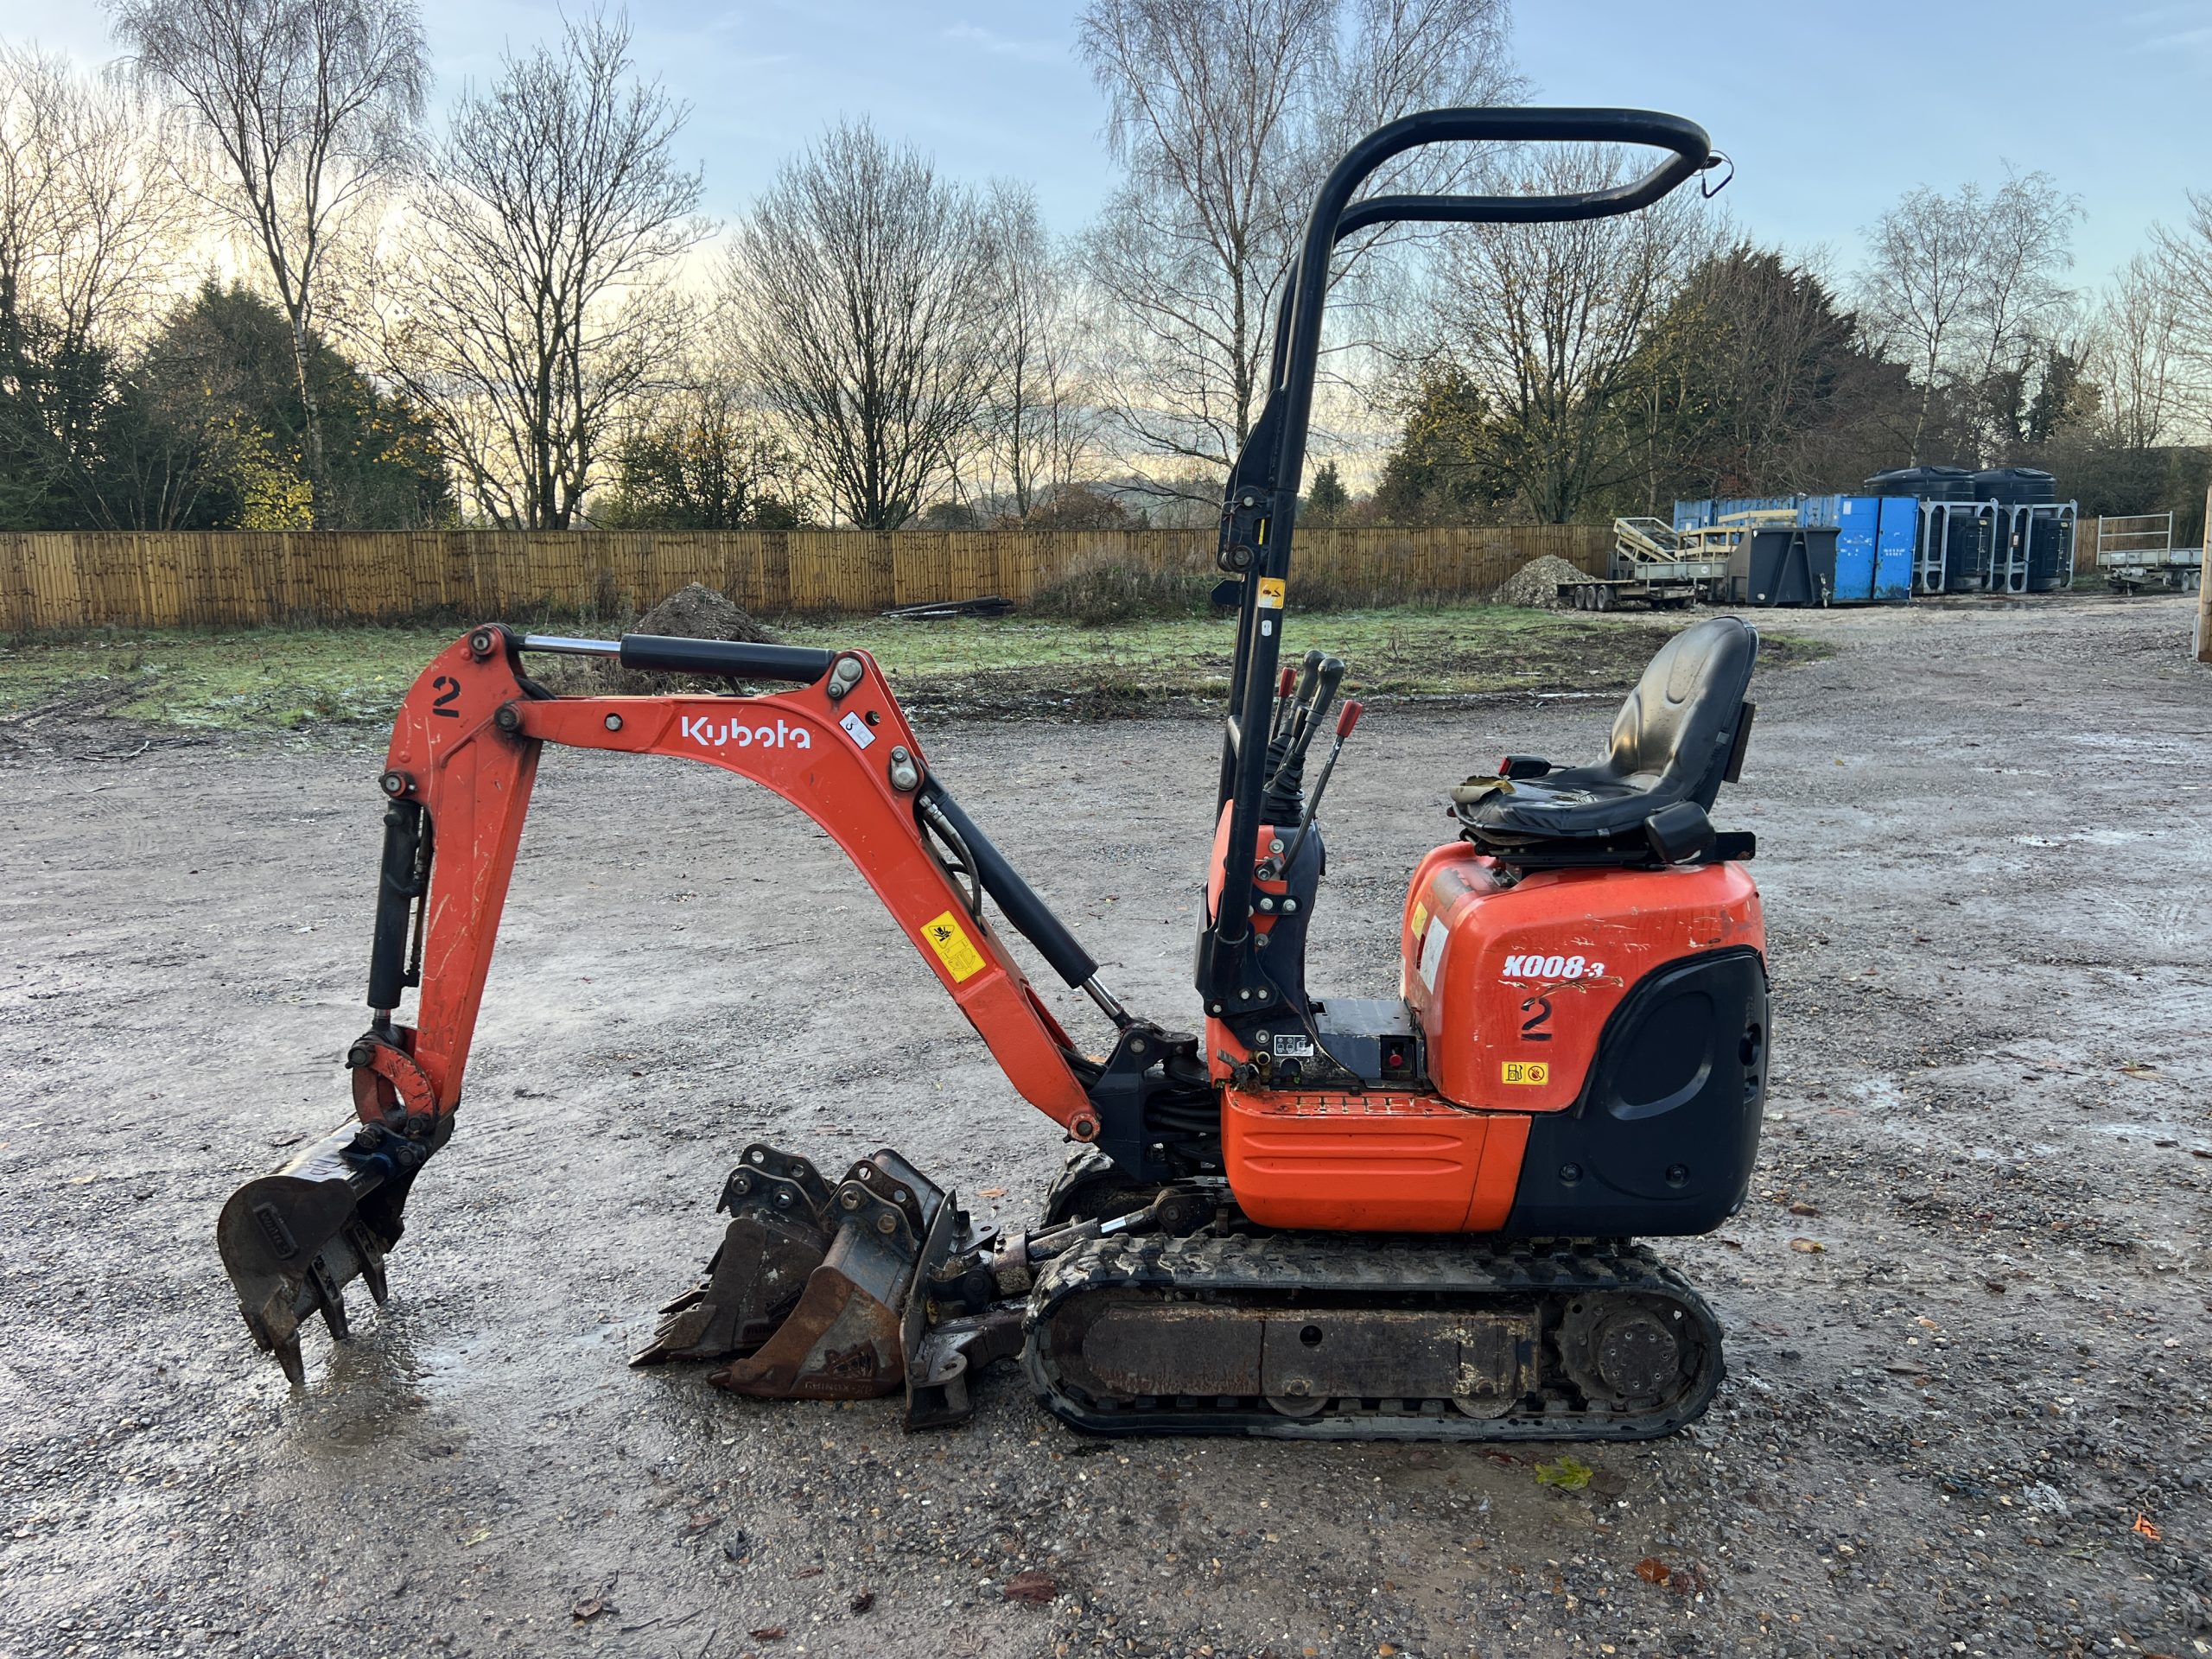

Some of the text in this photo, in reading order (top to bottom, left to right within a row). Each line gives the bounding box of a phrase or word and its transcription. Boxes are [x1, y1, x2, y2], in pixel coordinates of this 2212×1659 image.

[432, 676, 461, 718] 2
[681, 716, 810, 749] Kubota
[1502, 955, 1605, 979] K008-3
[1521, 997, 1552, 1041] 2
